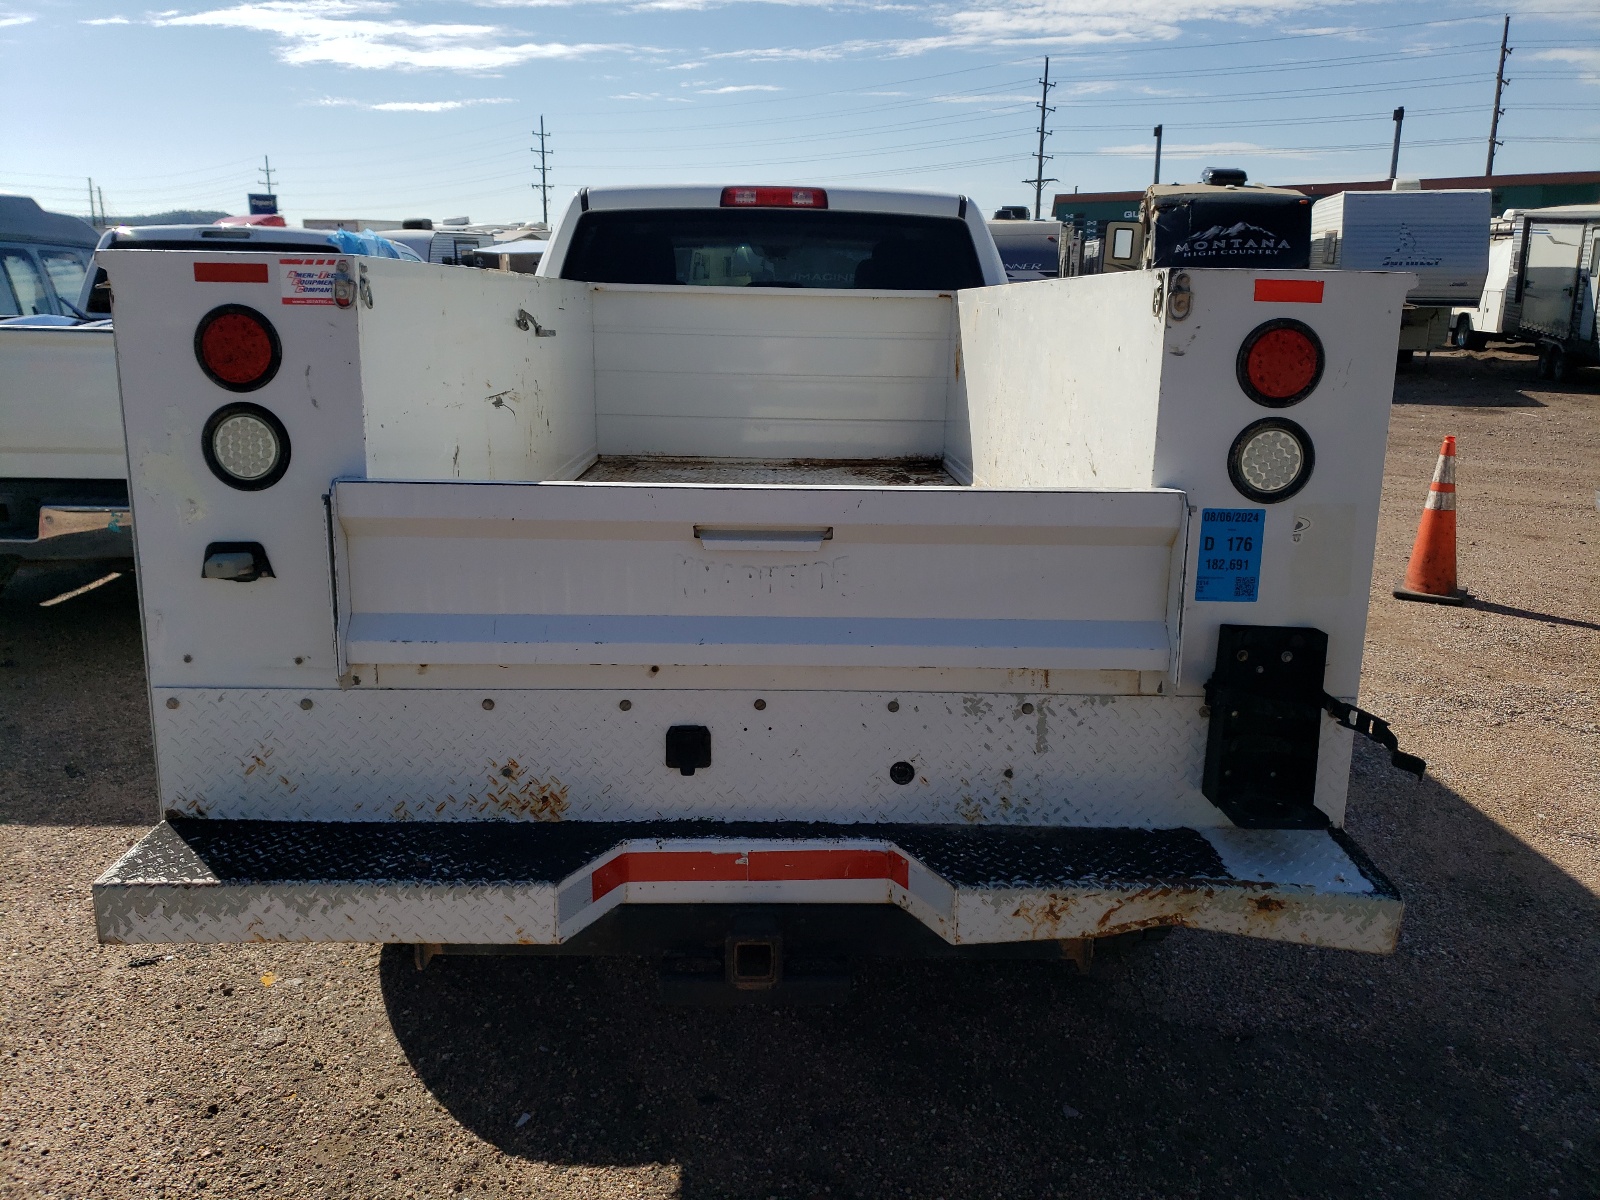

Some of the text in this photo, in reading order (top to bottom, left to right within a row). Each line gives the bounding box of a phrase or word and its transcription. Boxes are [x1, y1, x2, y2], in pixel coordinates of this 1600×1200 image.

[1174, 238, 1291, 253] MONTANA
[1183, 250, 1216, 258] HIGH
[1204, 511, 1259, 523] 08/06/2024
[1204, 536, 1253, 552] D 176
[1206, 558, 1249, 572] 182,691
